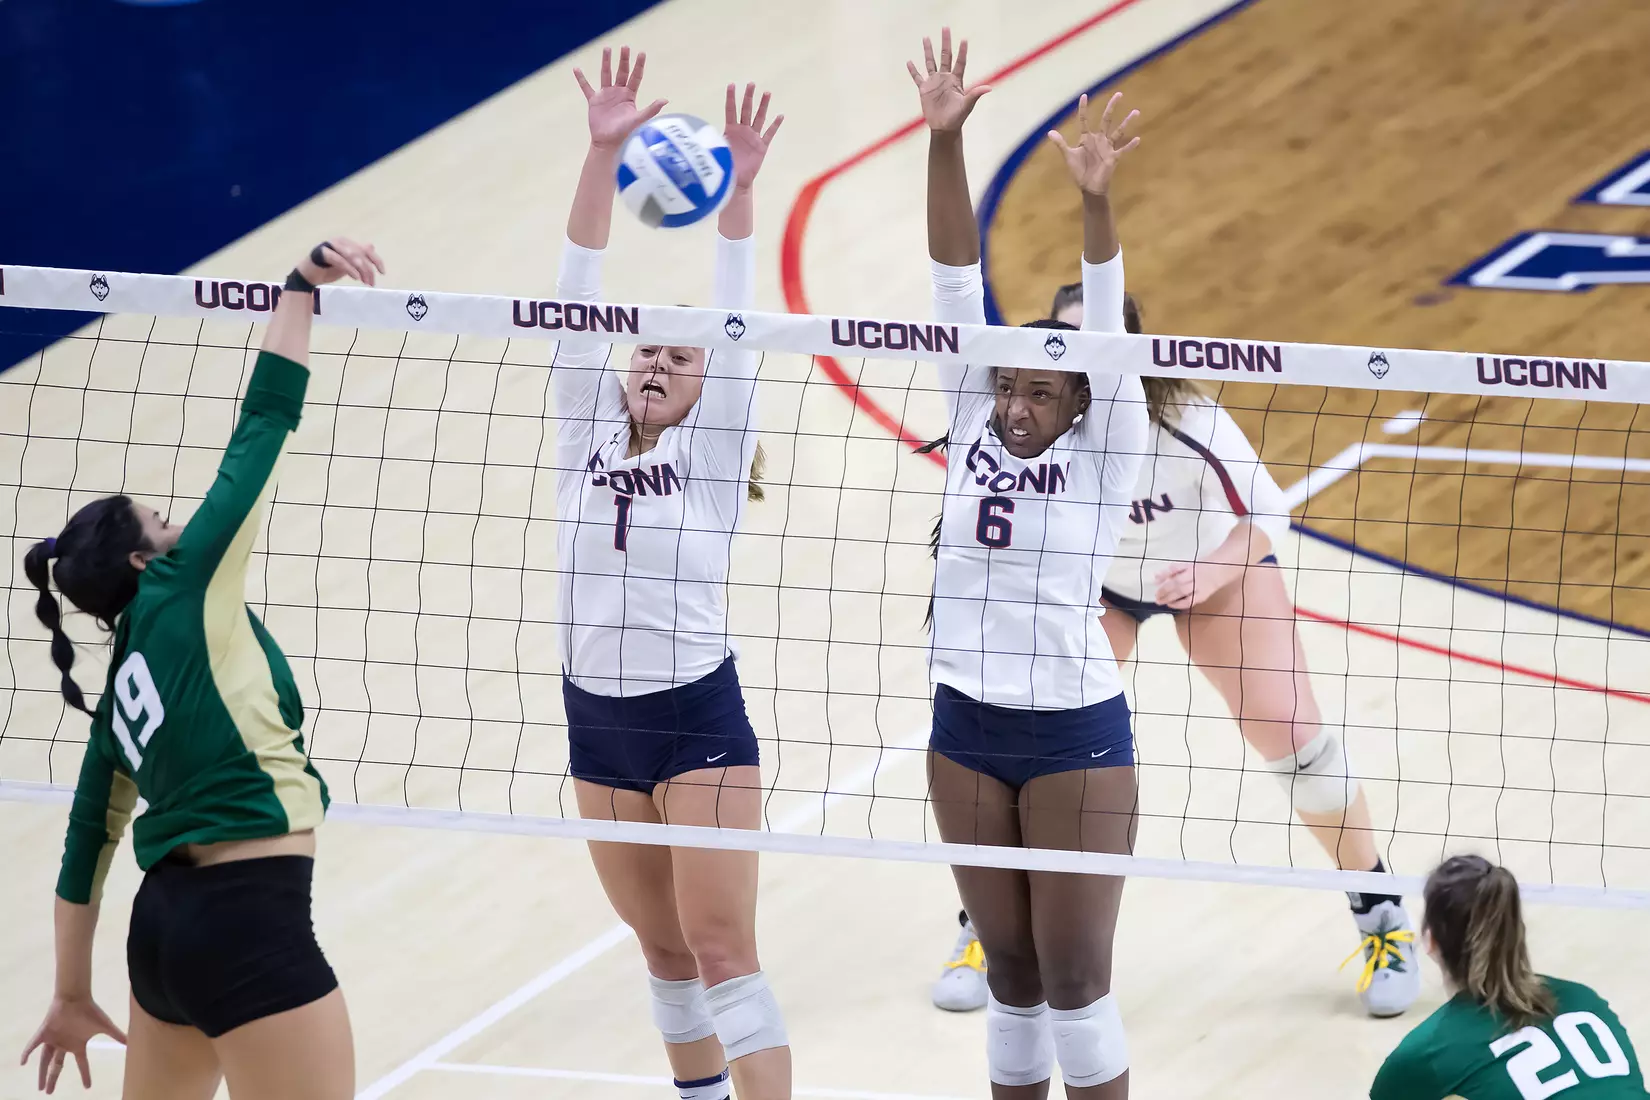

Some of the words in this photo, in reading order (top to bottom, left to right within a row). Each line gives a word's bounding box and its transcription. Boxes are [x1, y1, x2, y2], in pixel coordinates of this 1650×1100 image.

[512, 300, 640, 335] UCONN
[831, 318, 959, 354] UCONN
[1152, 338, 1282, 373] UCONN
[1476, 357, 1607, 390] UCONN
[613, 494, 633, 552] 1
[975, 495, 1015, 549] 6
[111, 651, 165, 772] 19
[1488, 1011, 1630, 1100] 20
